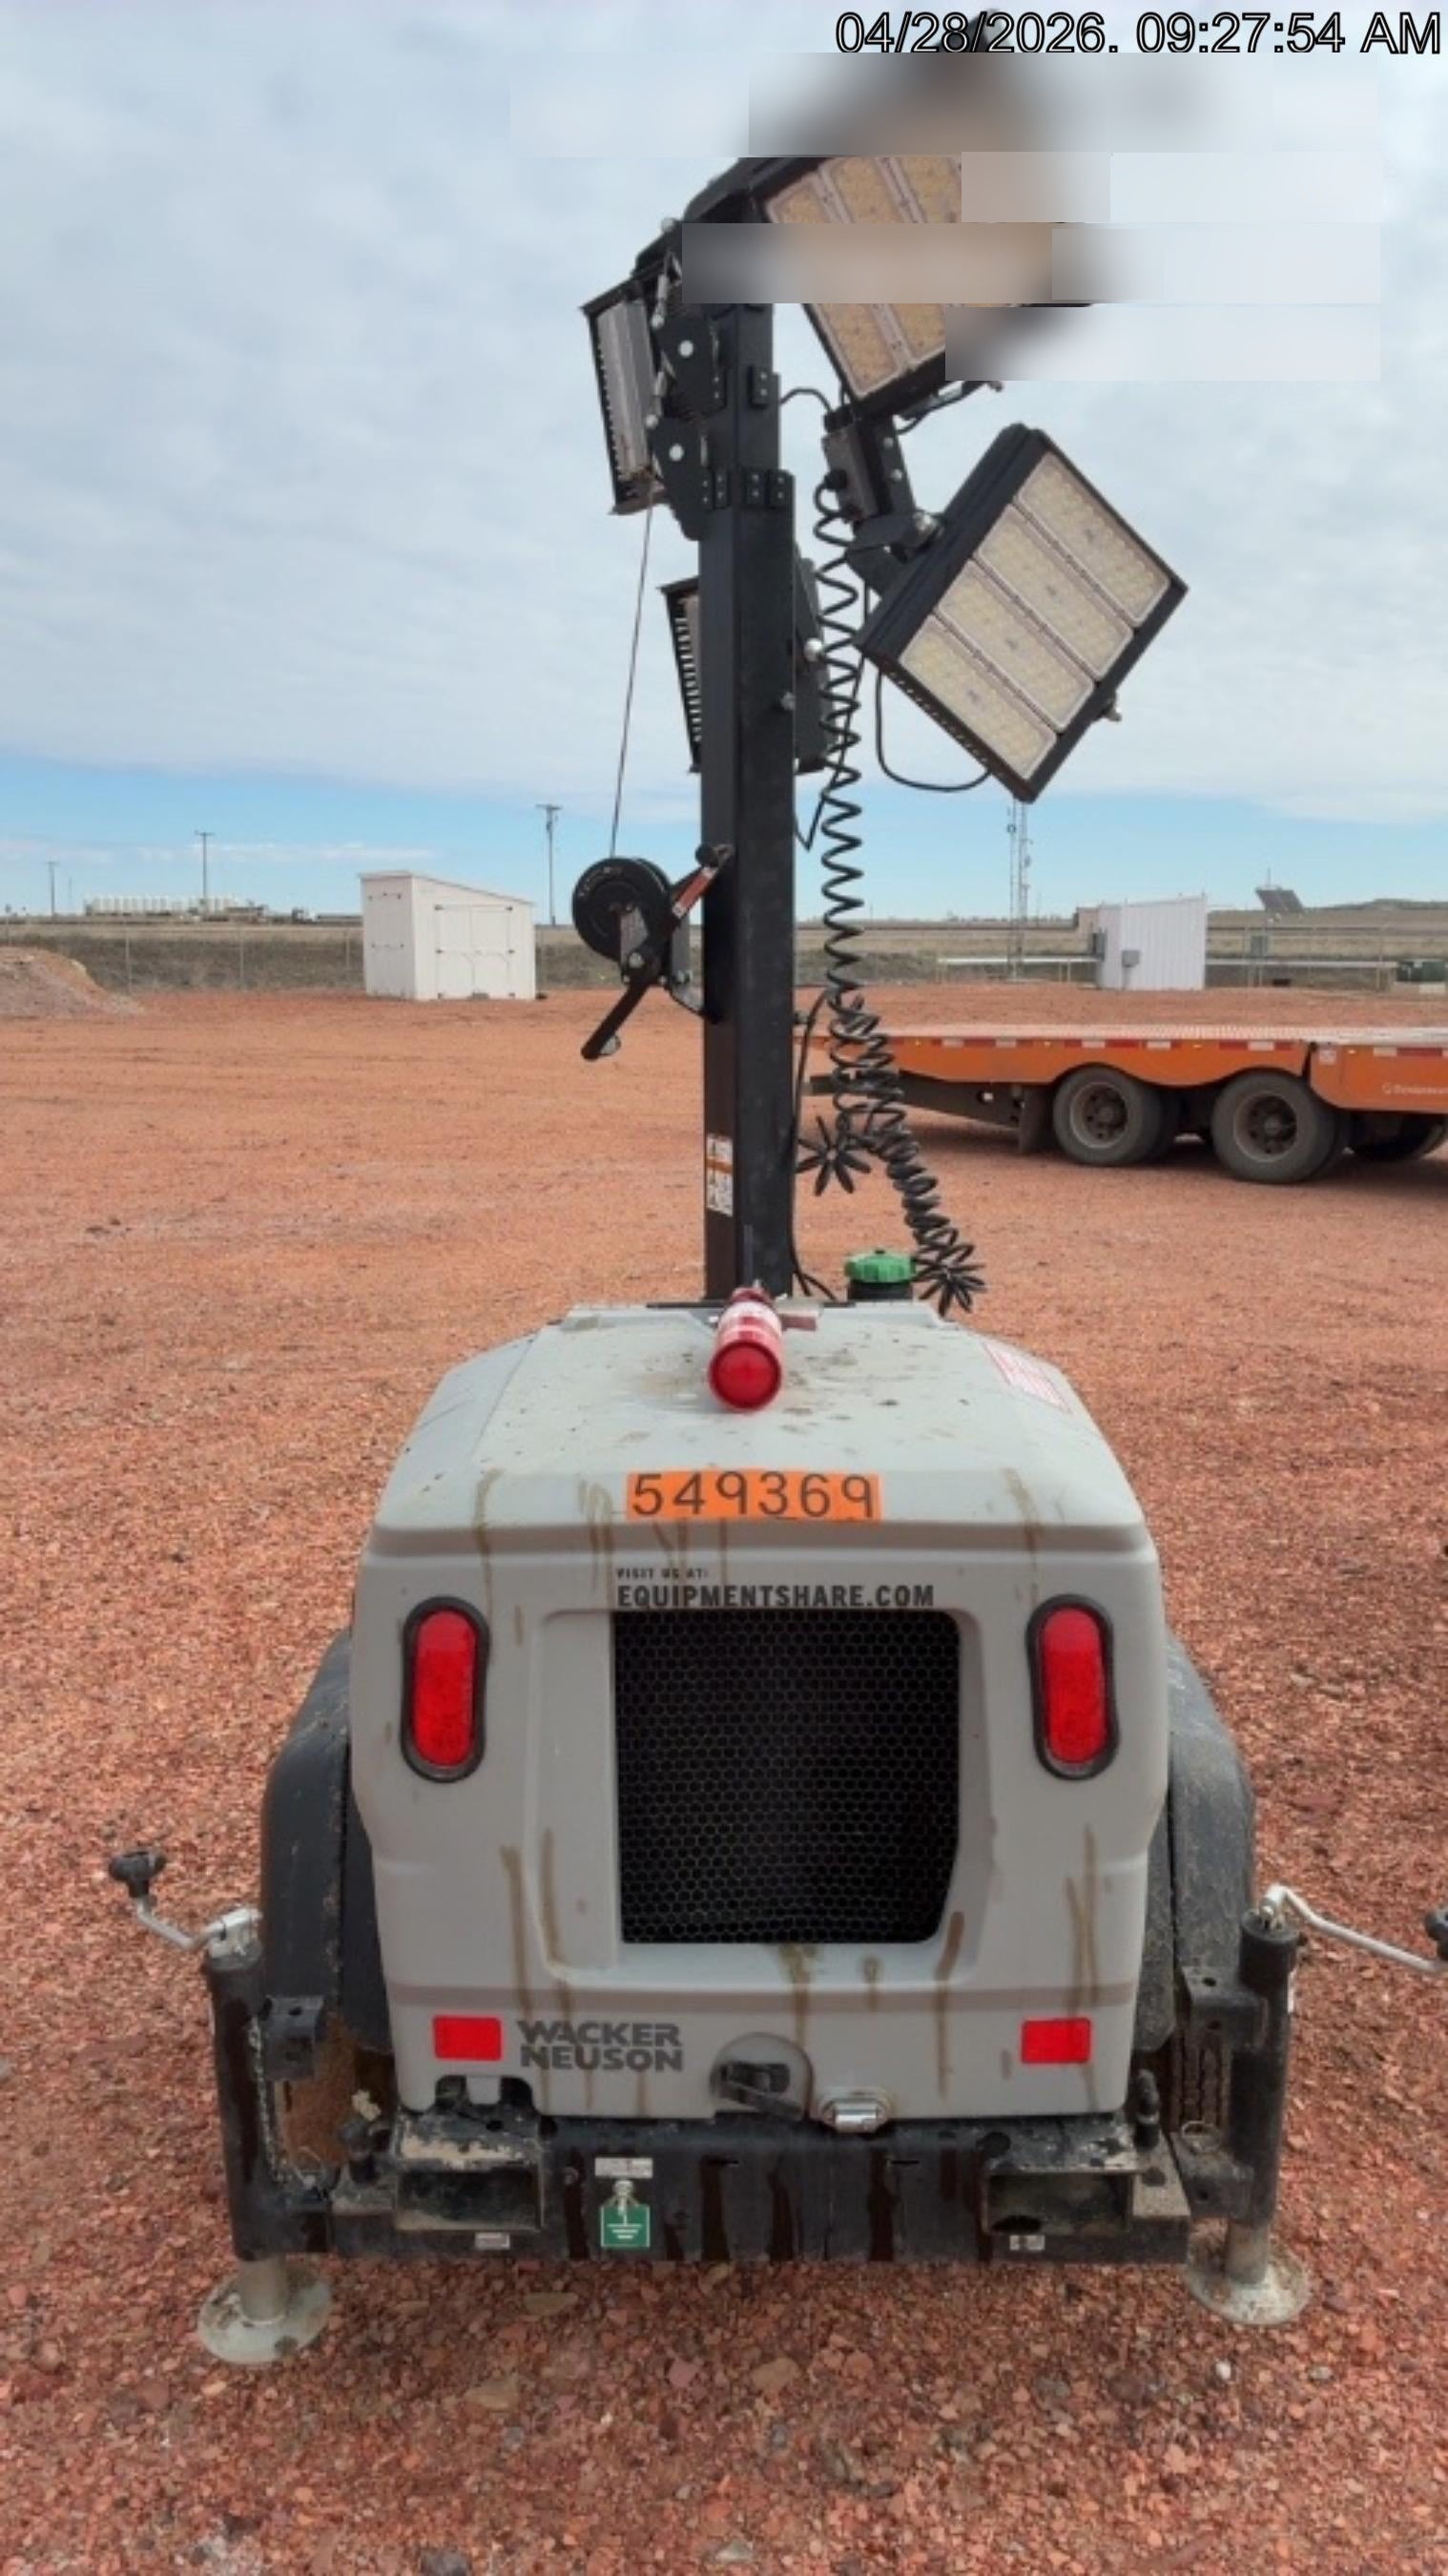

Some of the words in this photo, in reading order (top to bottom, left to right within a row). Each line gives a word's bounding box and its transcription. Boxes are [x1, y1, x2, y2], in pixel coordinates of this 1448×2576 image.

[631, 1470, 875, 1518] 549369
[616, 1568, 654, 1580] VISIT
[661, 1568, 680, 1580] US
[617, 1585, 934, 1608] EQUIPMENTSHARE.COM
[517, 2020, 682, 2047] WACKER
[520, 2045, 683, 2072] NEUSON
